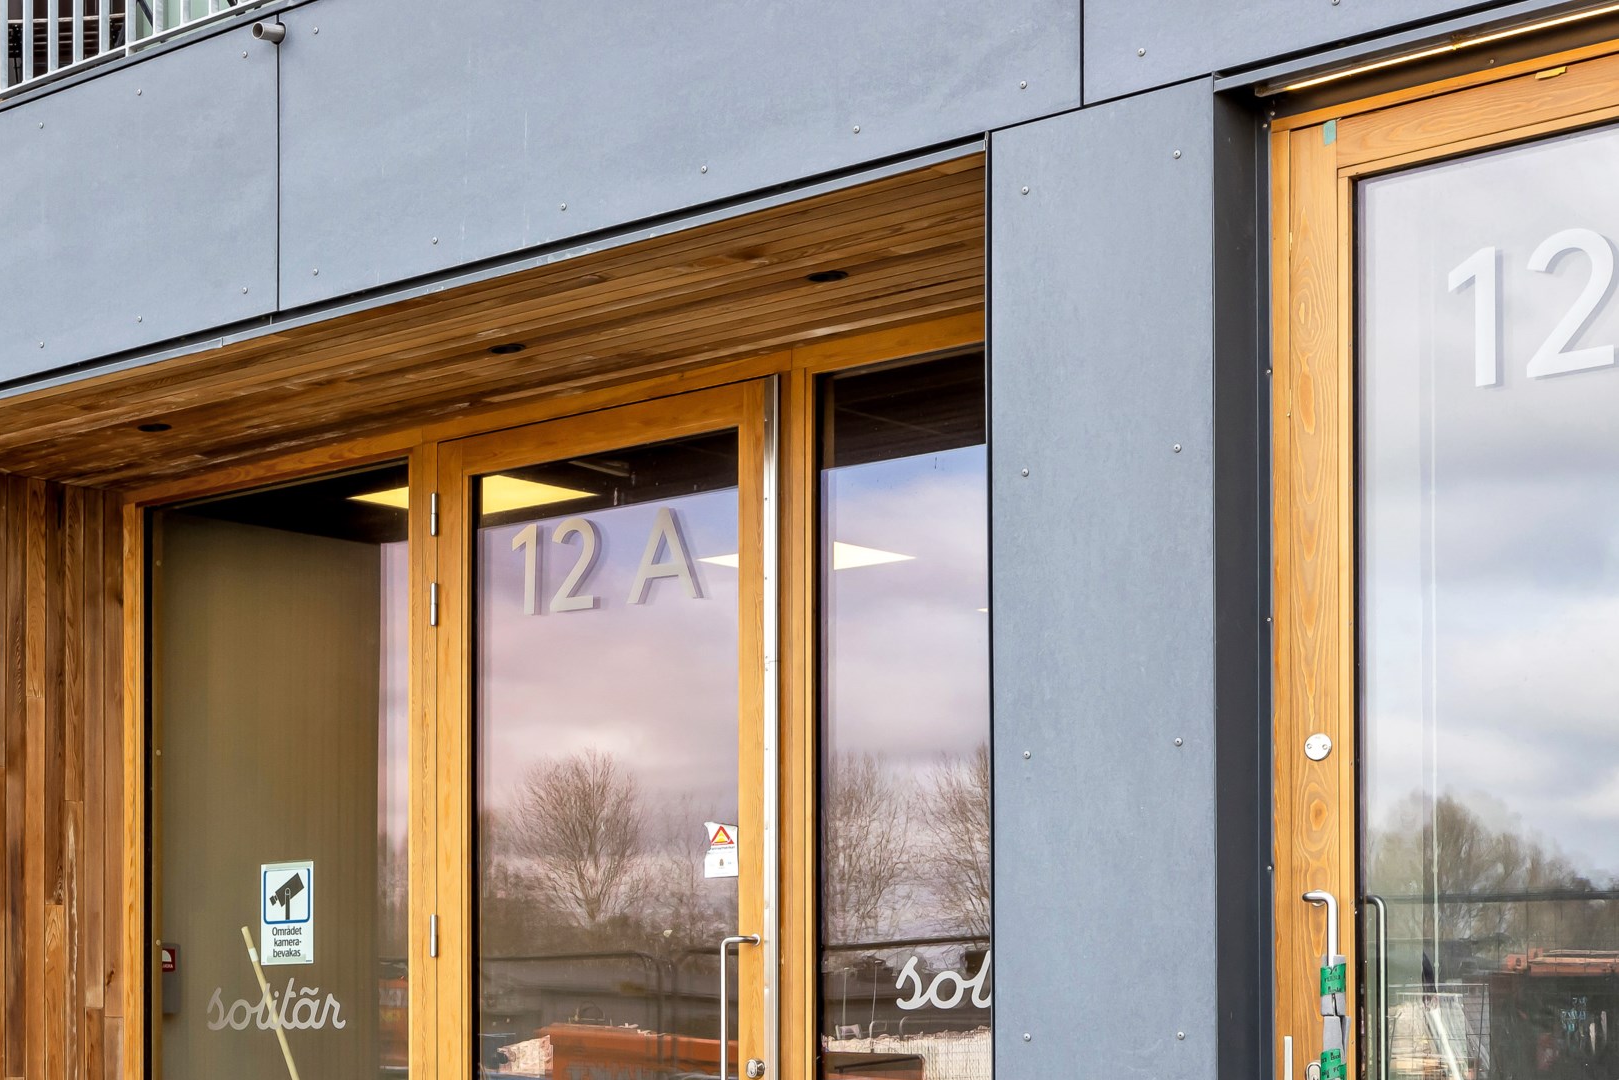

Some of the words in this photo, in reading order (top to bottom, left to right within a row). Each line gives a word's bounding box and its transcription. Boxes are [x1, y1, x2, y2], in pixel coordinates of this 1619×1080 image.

[1447, 227, 1616, 388] 12
[511, 517, 599, 616] 12
[627, 506, 703, 605] A
[271, 925, 303, 936] Området
[273, 937, 302, 947] kamera-
[272, 948, 301, 958] bevakas
